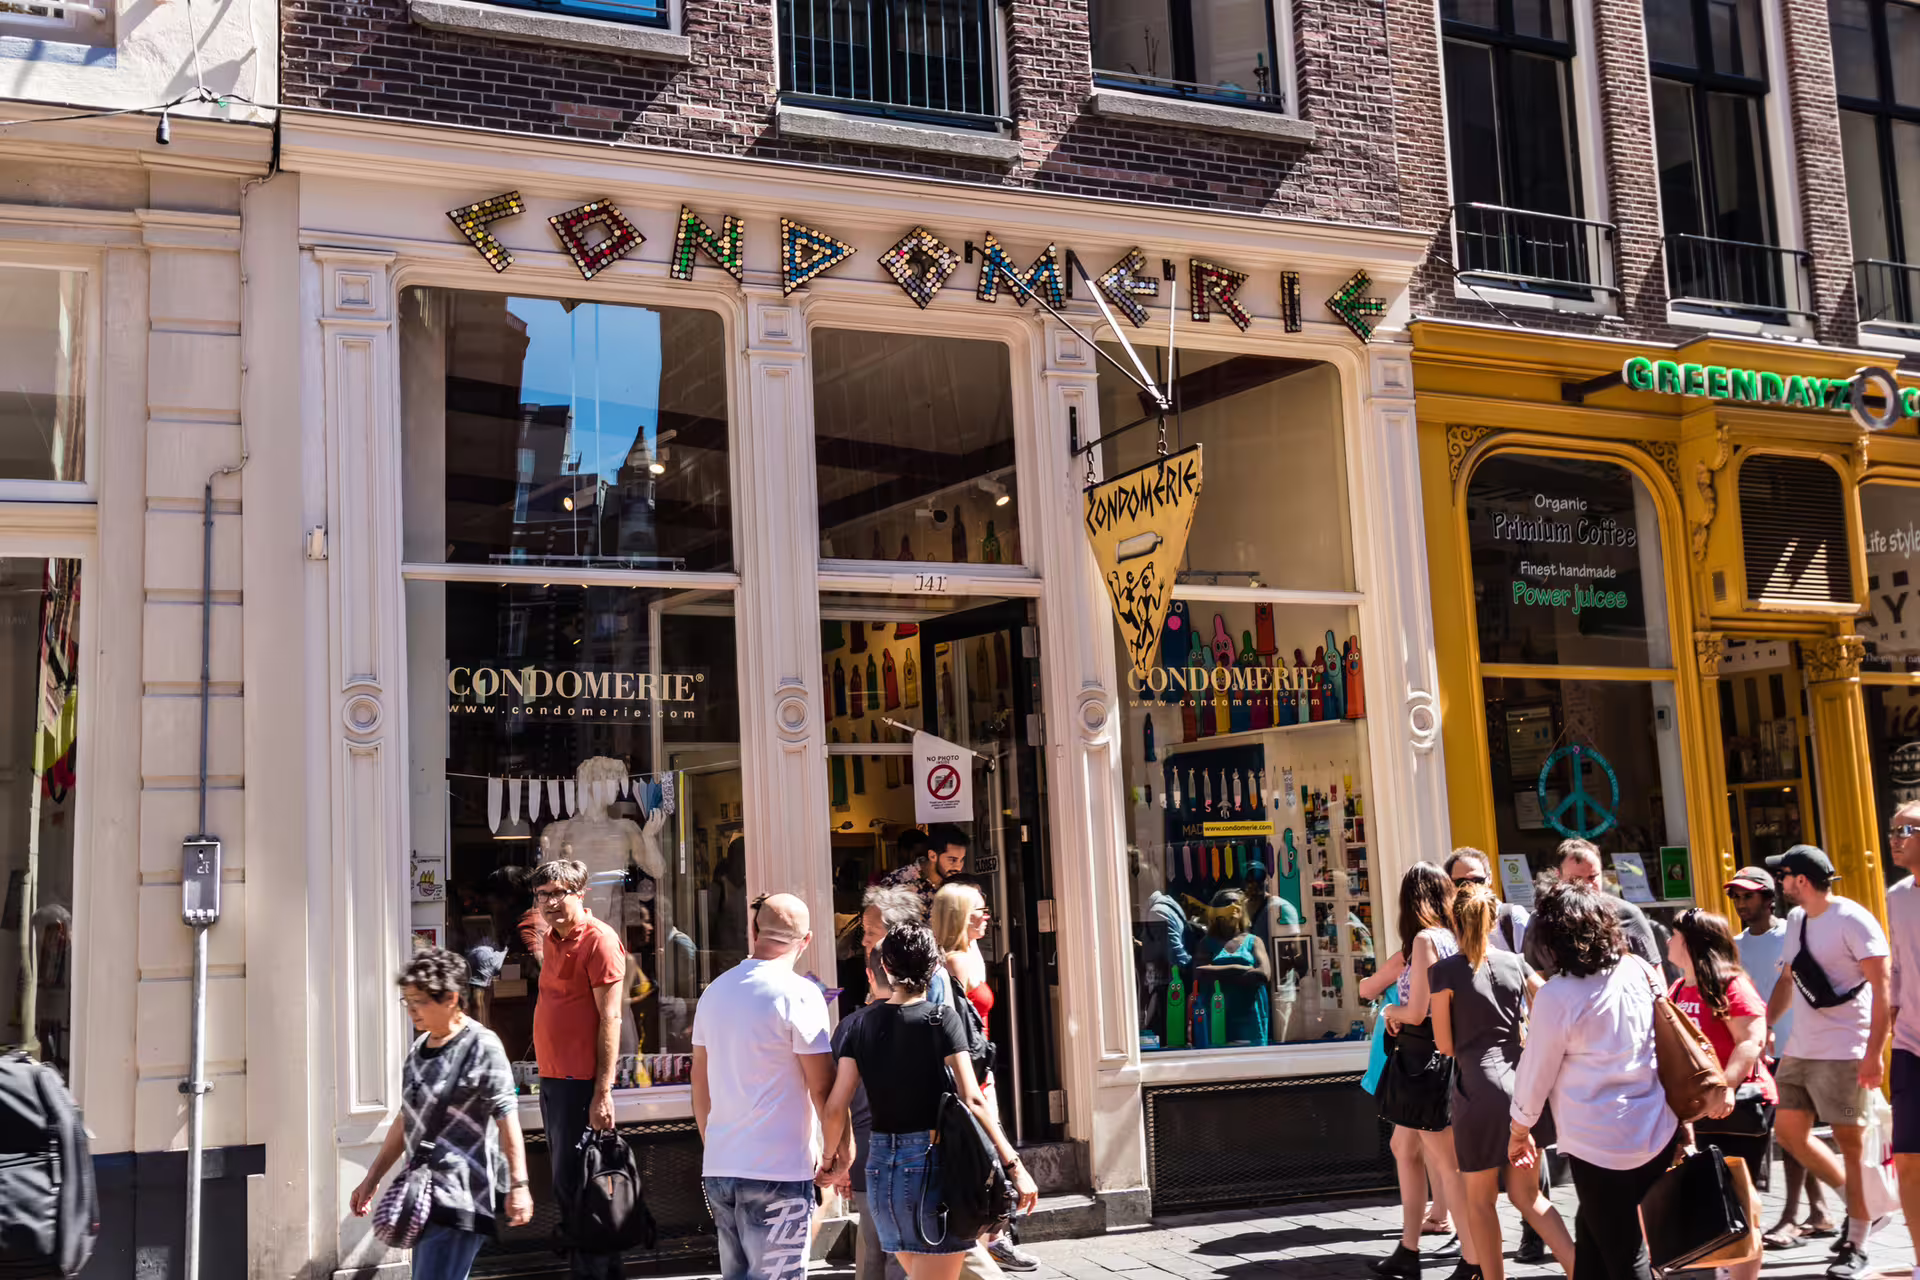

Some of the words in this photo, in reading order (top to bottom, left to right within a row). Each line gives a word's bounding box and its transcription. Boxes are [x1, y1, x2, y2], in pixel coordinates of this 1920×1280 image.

[445, 190, 1387, 343] CONDOMERIE
[1622, 356, 1854, 411] GREENDAYZ
[1086, 458, 1197, 536] CONDOMERIE
[1534, 493, 1588, 513] Organic
[1491, 512, 1573, 544] Primium
[1576, 517, 1637, 547] Coffee
[1520, 561, 1558, 576] Finest
[1559, 563, 1617, 578] handmade
[914, 575, 946, 592] 141
[1512, 580, 1571, 607] Power
[1572, 583, 1628, 614] juices
[448, 704, 695, 719] www.condomerie.com
[1129, 697, 1320, 708] www.condomerie.com
[1204, 823, 1273, 832] www.condomerie.com
